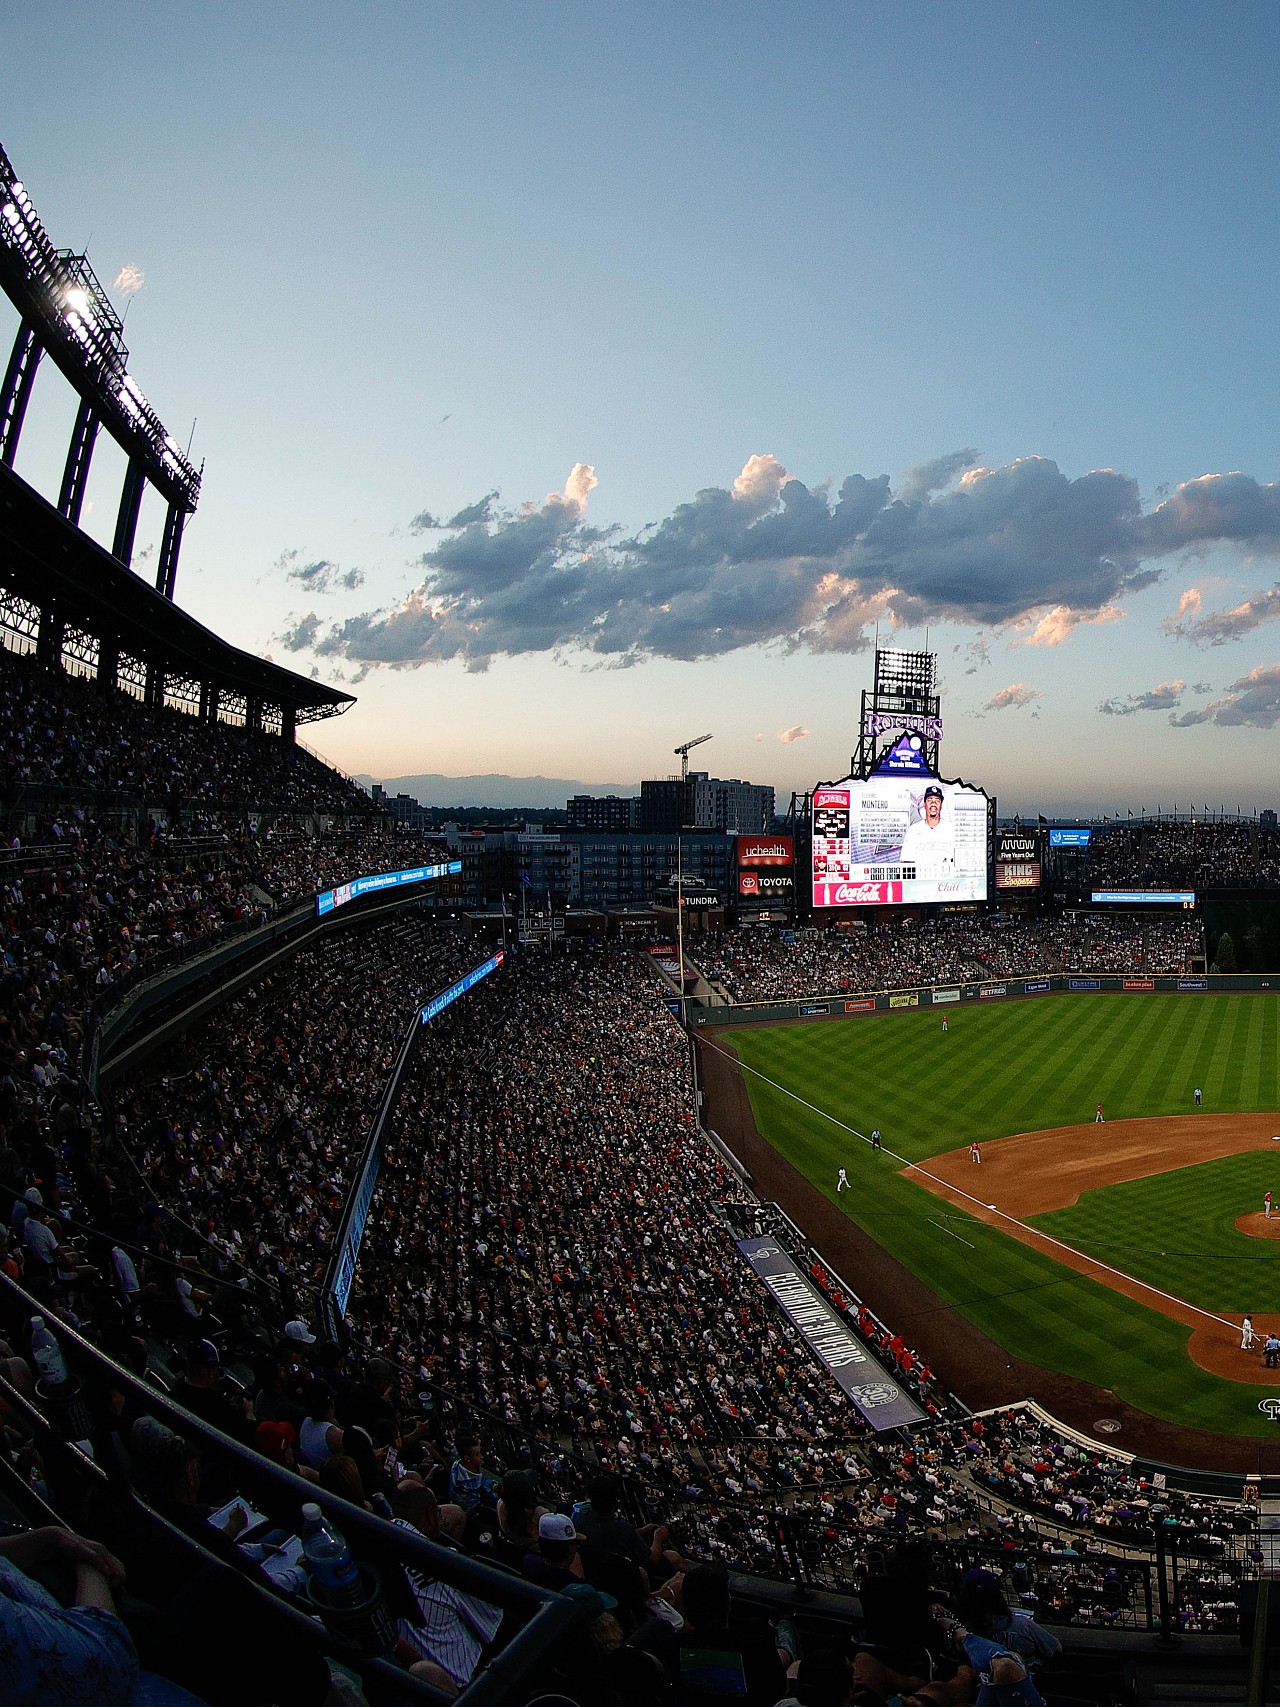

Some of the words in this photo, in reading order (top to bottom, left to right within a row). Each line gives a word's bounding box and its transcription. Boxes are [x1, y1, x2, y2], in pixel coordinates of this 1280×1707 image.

[865, 713, 944, 740] ROCKIES
[861, 800, 889, 809] MONTERO
[745, 844, 786, 856] uchealth
[1004, 864, 1033, 876] KING
[758, 878, 793, 887] TOYOTA
[938, 881, 960, 892] Chill
[835, 883, 881, 902] Coca-Cola
[686, 897, 718, 905] TUNDRA
[980, 987, 1005, 996] BETFRED
[764, 1272, 830, 1329] CELEBRATING
[802, 1321, 841, 1338] 30
[812, 1334, 868, 1368] YEARS
